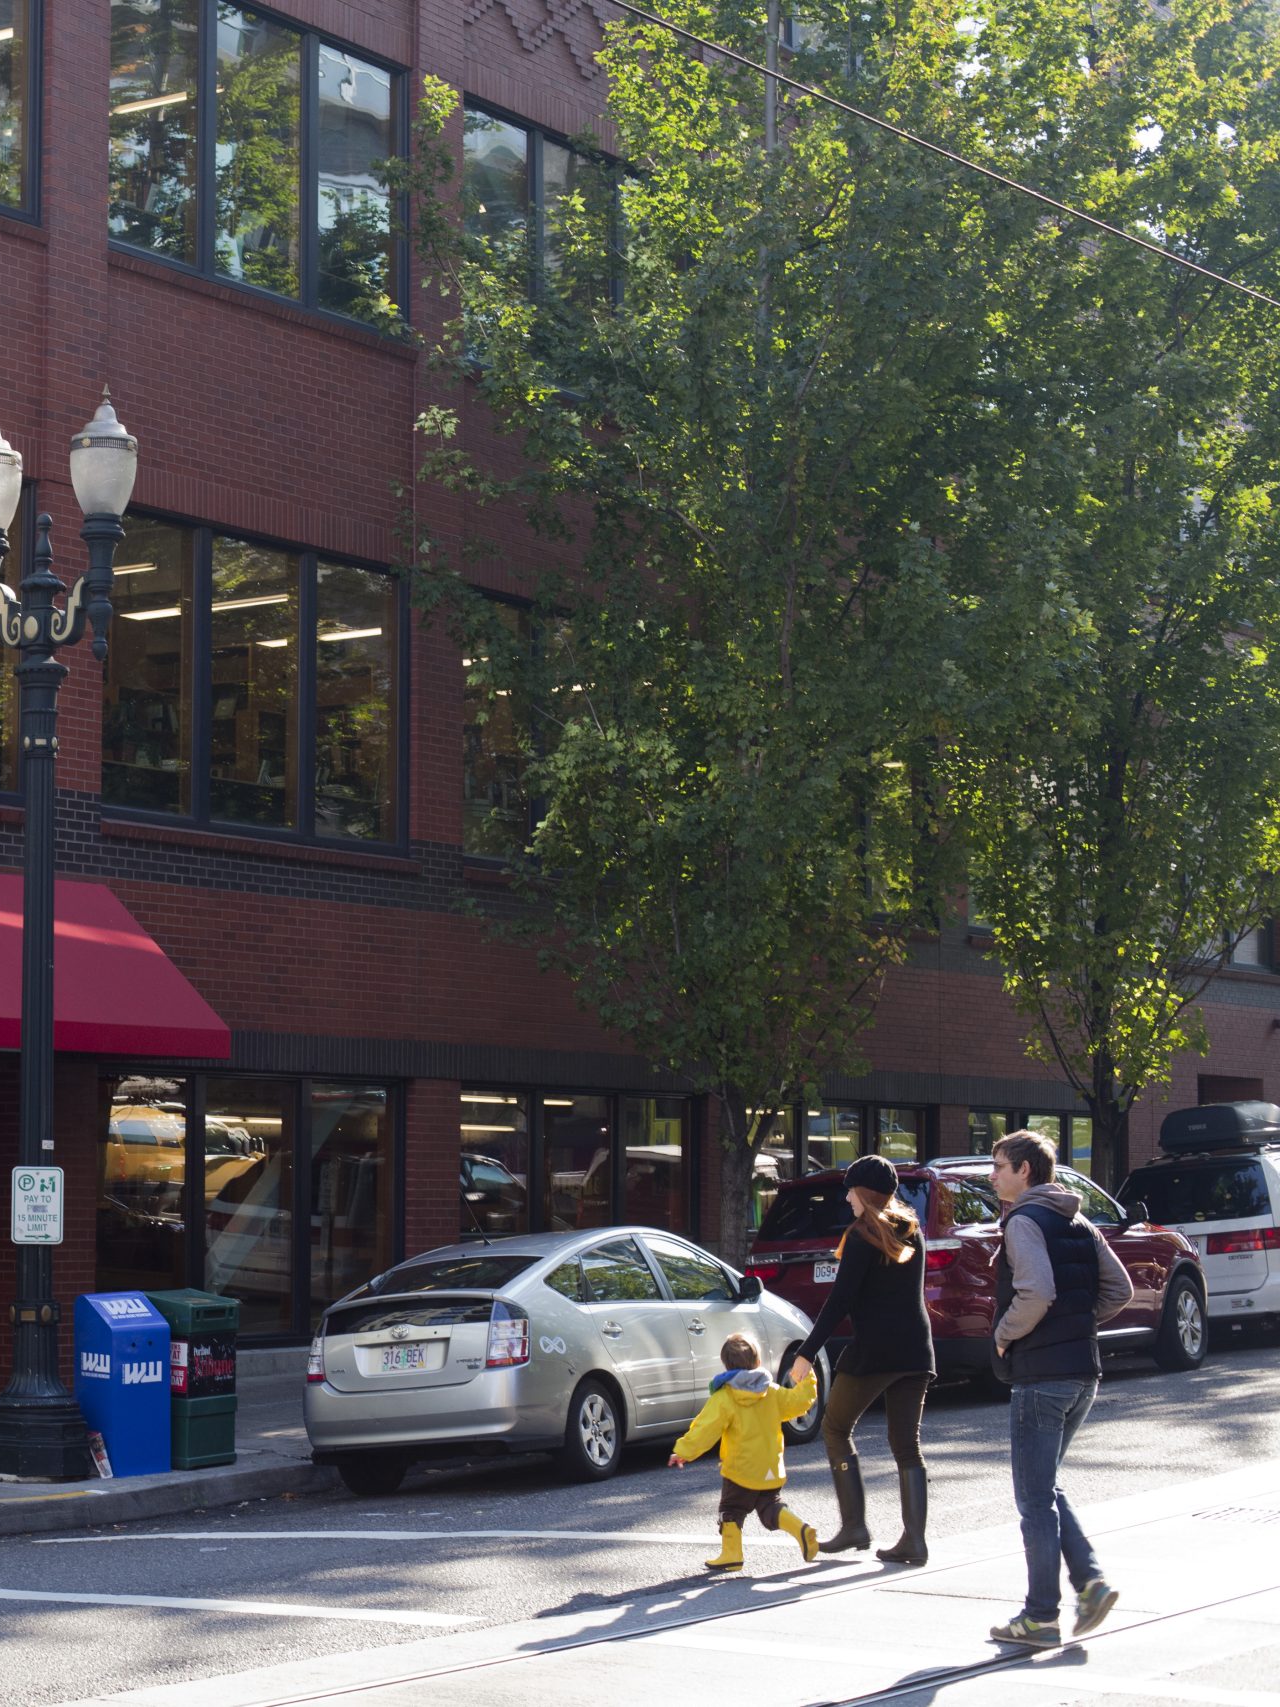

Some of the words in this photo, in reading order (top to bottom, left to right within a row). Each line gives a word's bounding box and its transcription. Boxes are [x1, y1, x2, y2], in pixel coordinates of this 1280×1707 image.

[24, 1195, 39, 1204] PAY
[40, 1195, 52, 1204] TO
[18, 1214, 26, 1222] 15
[27, 1214, 58, 1222] MINUTE
[27, 1224, 48, 1232] LIMIT
[383, 1350, 401, 1365] 316
[406, 1348, 425, 1363] BEK
